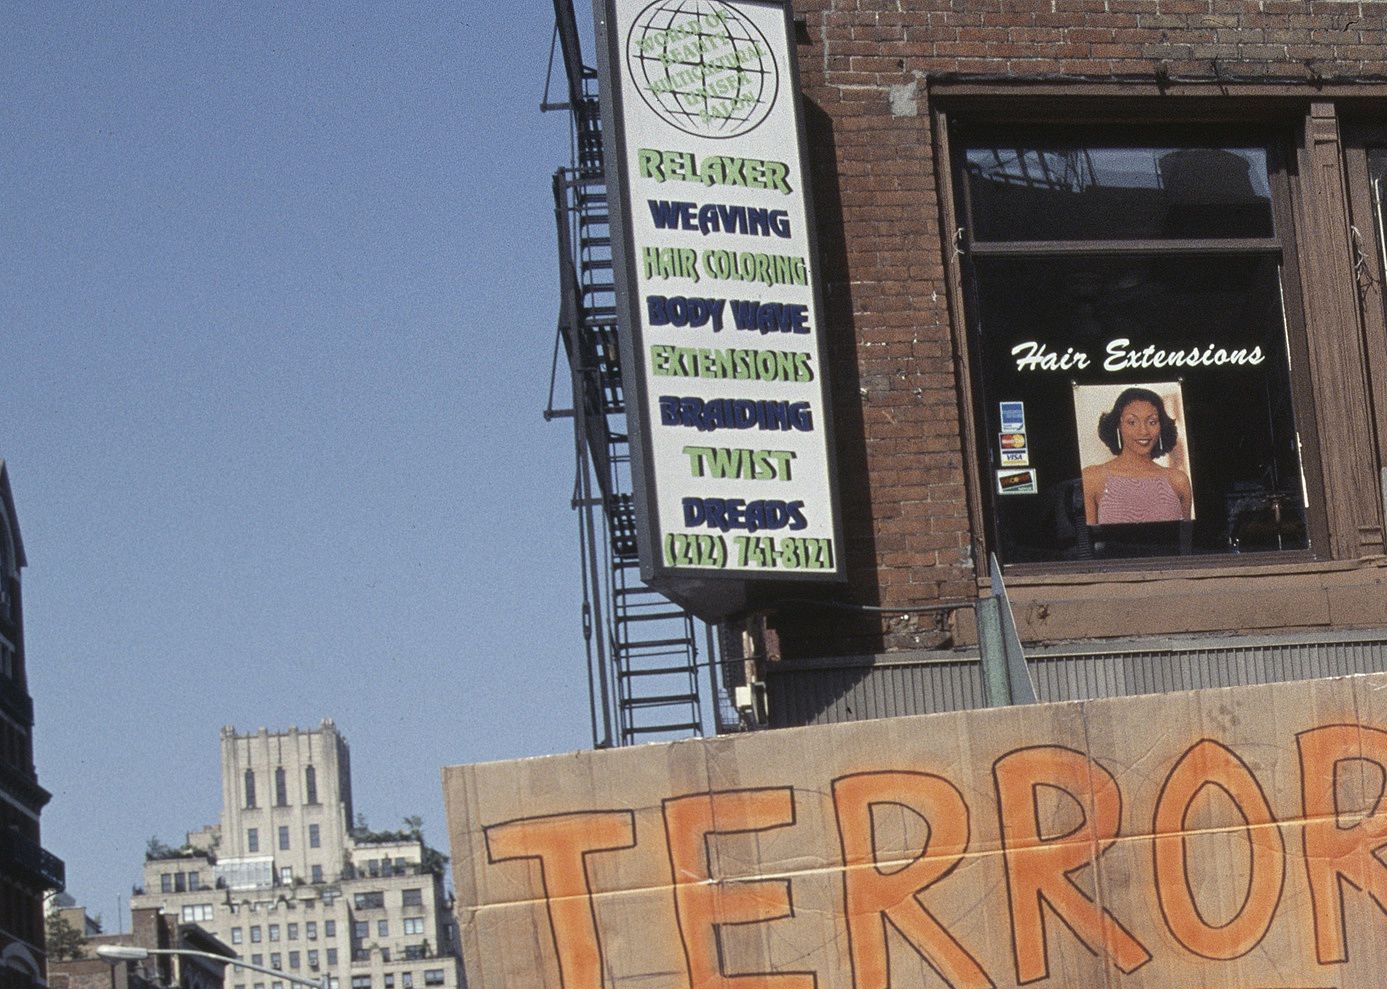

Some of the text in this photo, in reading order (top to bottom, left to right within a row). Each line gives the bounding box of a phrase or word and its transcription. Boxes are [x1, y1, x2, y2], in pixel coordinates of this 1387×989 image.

[635, 9, 729, 53] WORLD OF
[659, 30, 730, 68] BEAUTY
[650, 43, 766, 96] MULTICULTURAL
[685, 71, 751, 105] UNISEX
[701, 92, 758, 124] SALON
[637, 148, 793, 195] RELAXER
[647, 199, 792, 239] WEAVING
[642, 247, 809, 287] HAIR COLORING
[646, 295, 811, 335] BODY WAVE
[650, 344, 815, 383] EXTENSIONS
[1011, 338, 1265, 371] Hair Extensions
[658, 395, 815, 432] BRAIDING
[682, 445, 798, 481] TWIST
[682, 497, 808, 533] DREADS
[664, 533, 834, 570] (212) 741-8121
